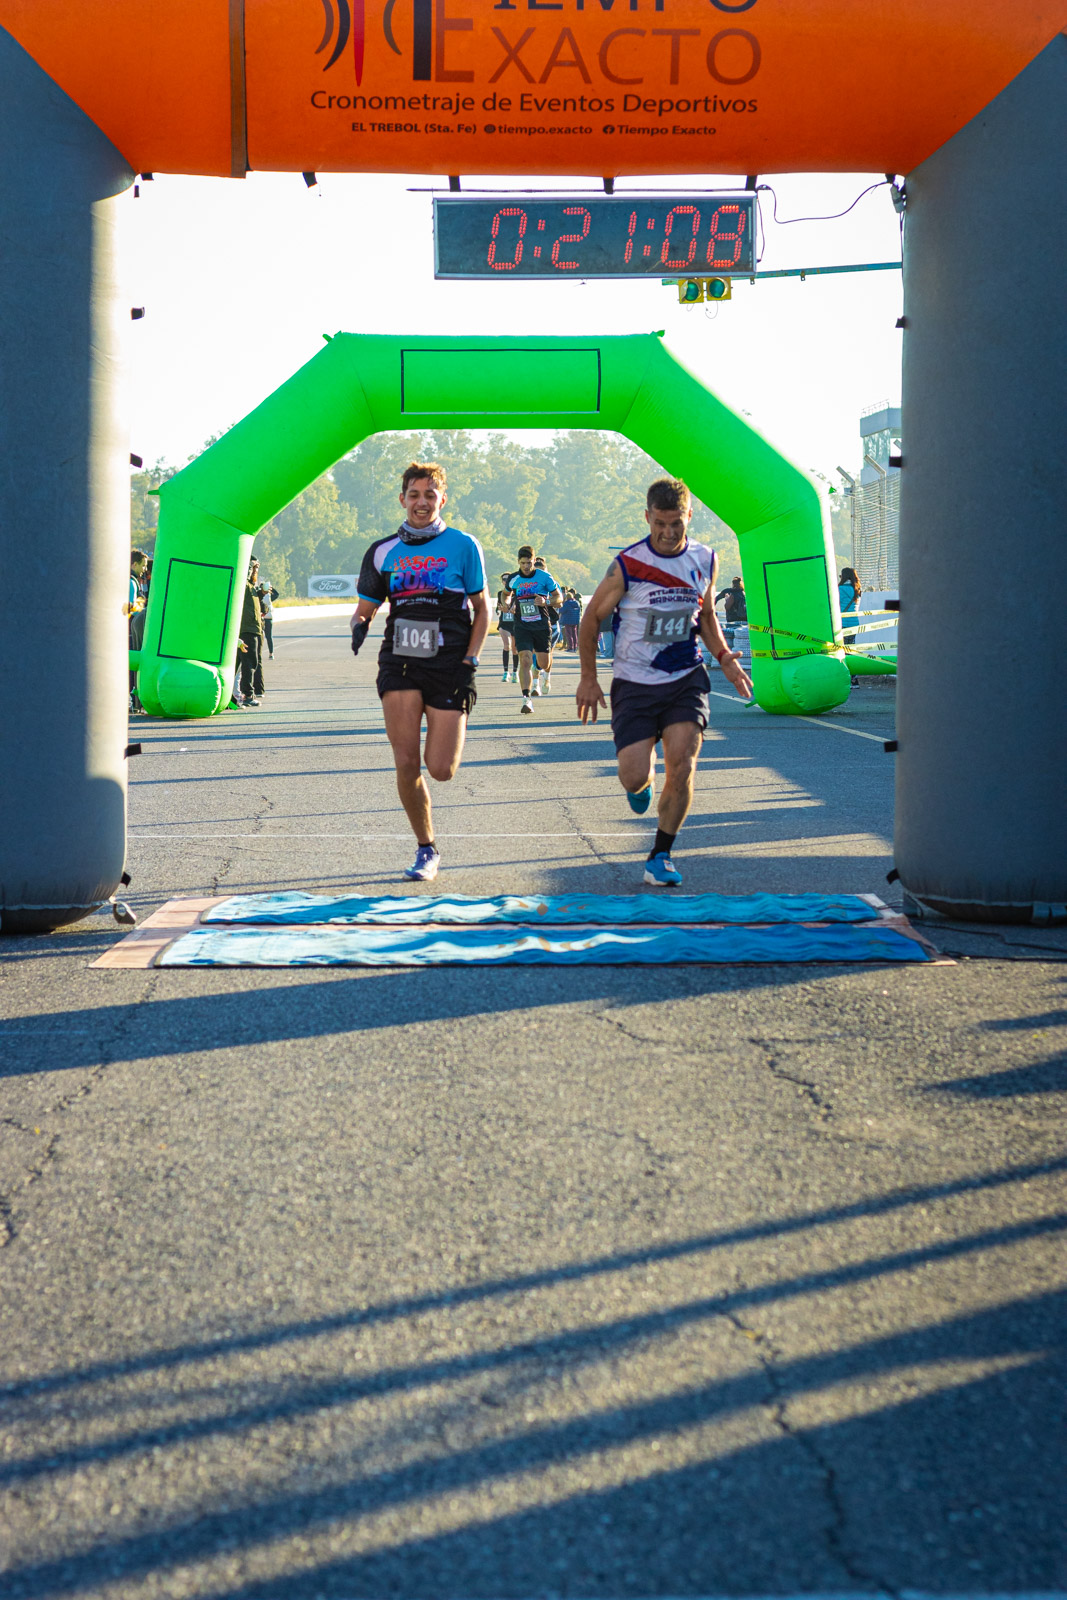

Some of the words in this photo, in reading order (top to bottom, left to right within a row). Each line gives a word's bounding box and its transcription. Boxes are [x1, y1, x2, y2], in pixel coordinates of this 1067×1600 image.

[310, 90, 475, 116] Cronometraje
[481, 92, 512, 112] de
[520, 93, 615, 113] Eventos
[623, 94, 758, 117] Deportivos
[351, 122, 367, 132] EL
[369, 122, 421, 133] TREBOL
[424, 122, 454, 134] (Sta.
[457, 123, 477, 134] Fe)
[498, 124, 593, 136] tiempo.exacto
[617, 124, 669, 136] Tiempo
[672, 125, 717, 136] Exacto
[318, 580, 343, 591] Ford
[522, 604, 536, 614] 129
[653, 617, 685, 636] 144
[401, 626, 431, 649] 104
